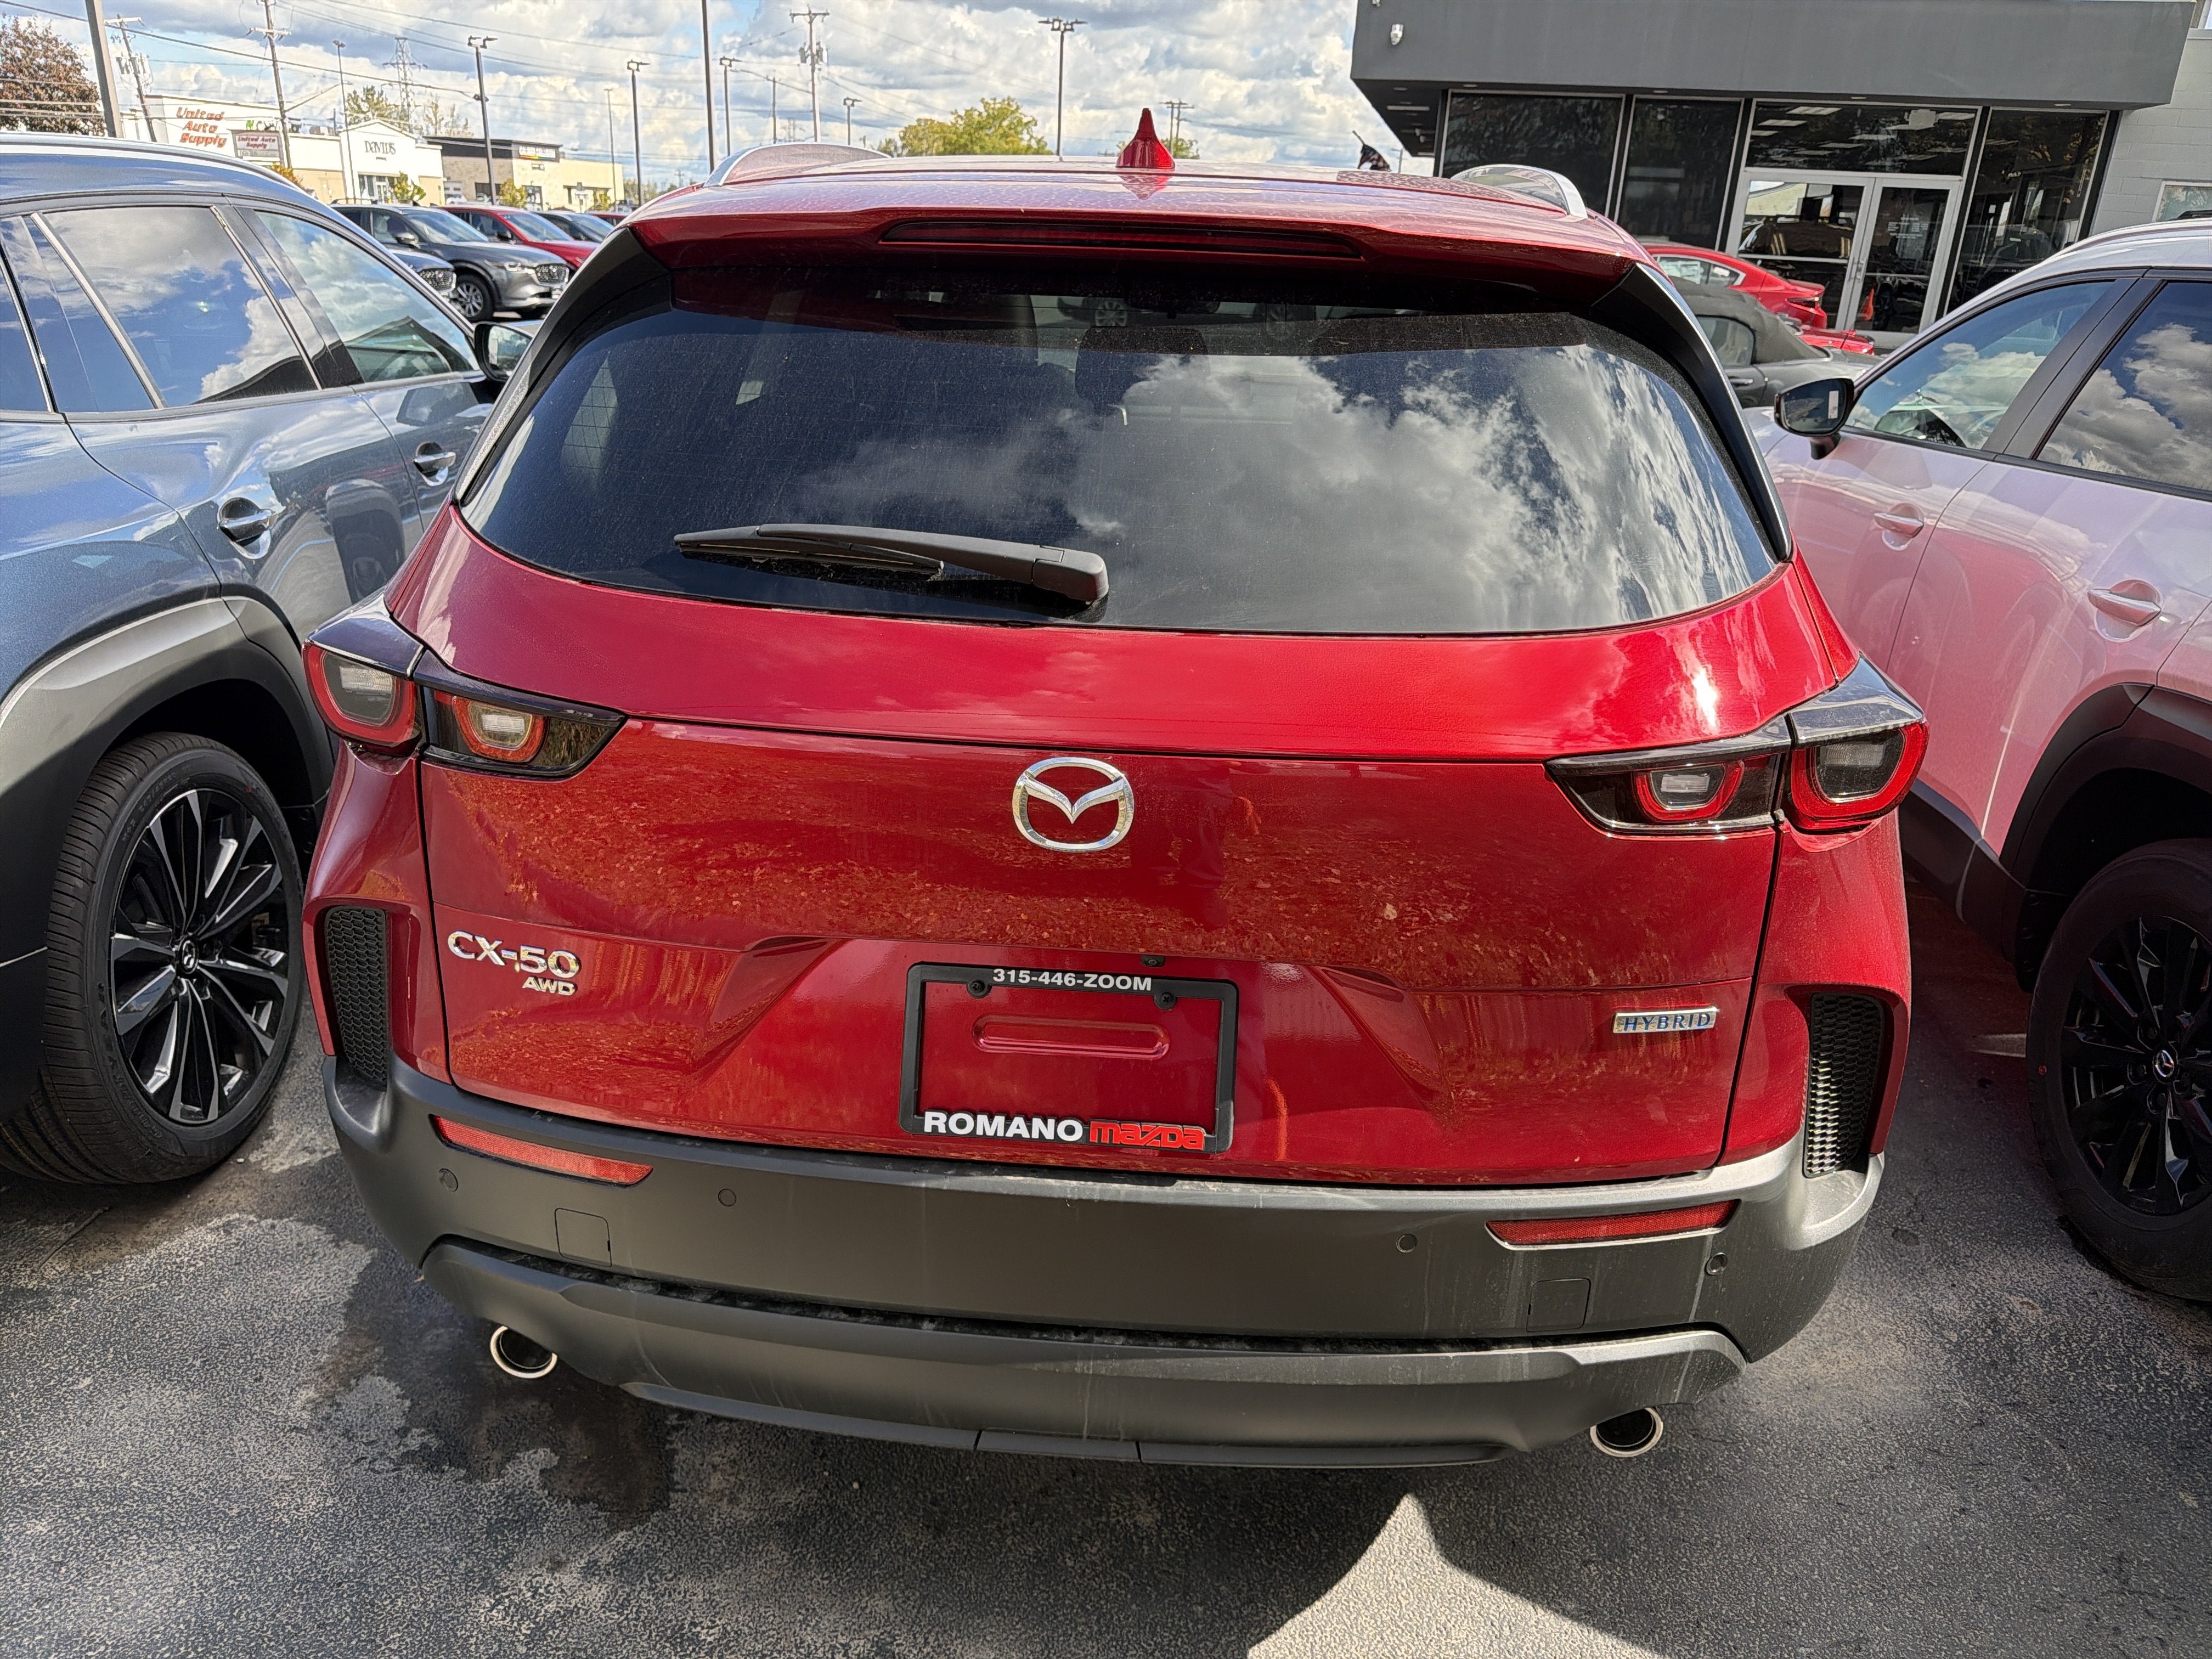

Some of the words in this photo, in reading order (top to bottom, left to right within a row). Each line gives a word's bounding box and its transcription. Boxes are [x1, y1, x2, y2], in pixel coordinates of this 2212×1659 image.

[176, 107, 225, 121] United
[182, 121, 218, 133] Auto
[179, 133, 228, 148] Supply
[447, 929, 581, 979] CX-50
[522, 976, 577, 996] AWD
[992, 968, 1152, 992] 315-446-ZOOM
[1622, 1013, 1711, 1032] HYBRID
[923, 1110, 1083, 1142] ROMANO
